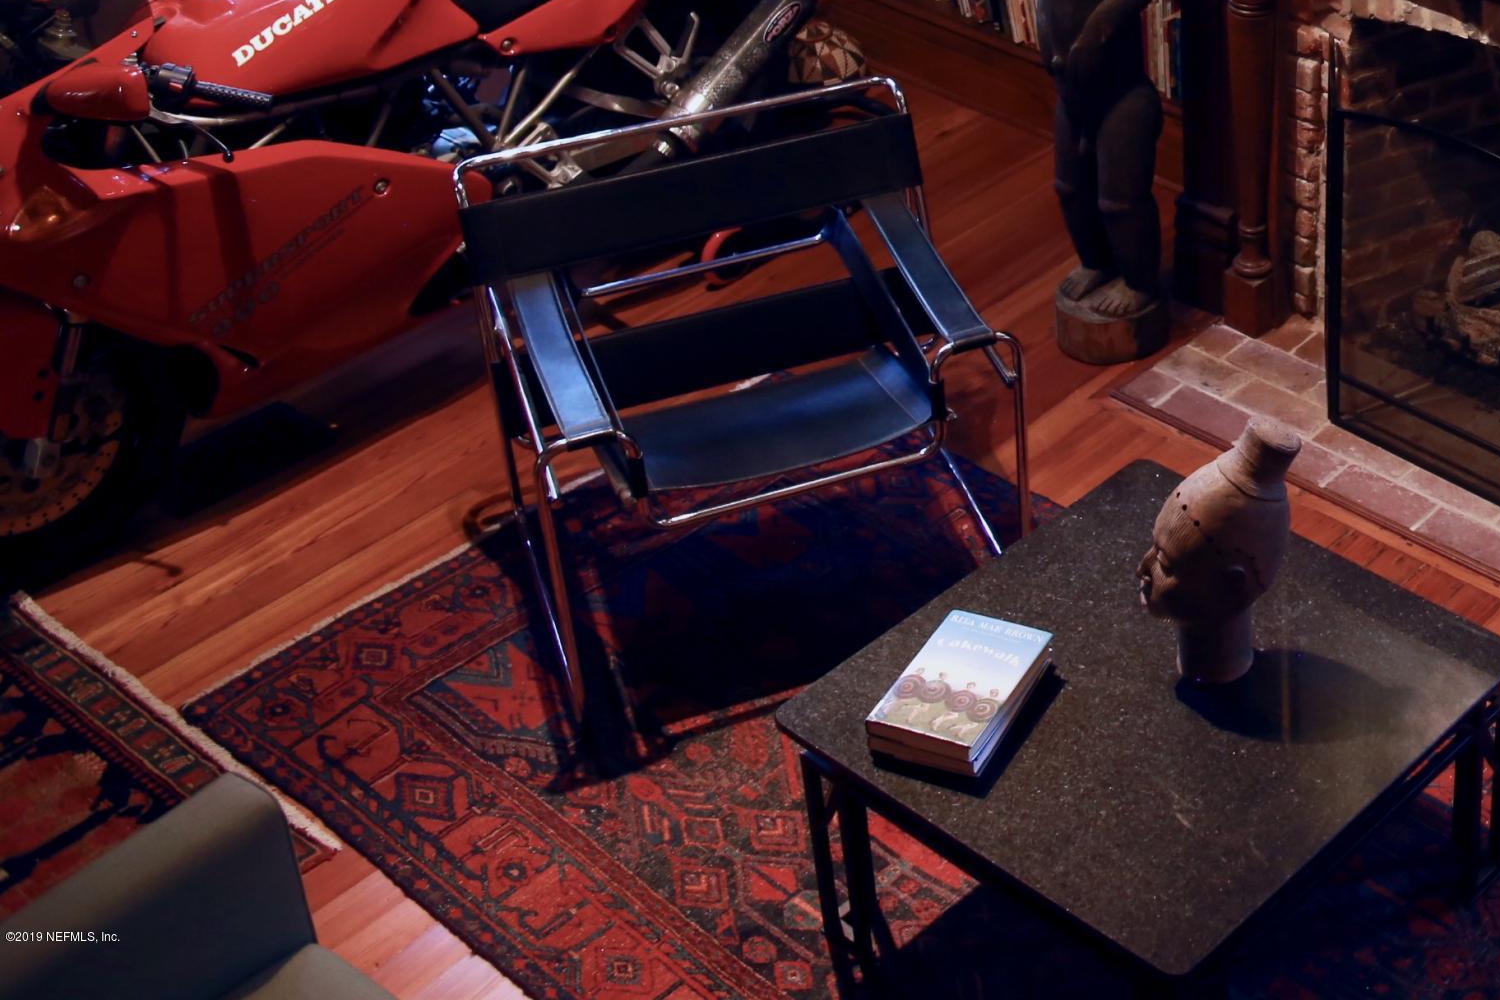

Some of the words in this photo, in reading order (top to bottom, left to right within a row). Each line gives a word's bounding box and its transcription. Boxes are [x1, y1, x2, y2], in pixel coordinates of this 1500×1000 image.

[979, 621, 1002, 634] MAE
[1004, 628, 1045, 643] BROWN
[936, 637, 1020, 667] Cakewalk
